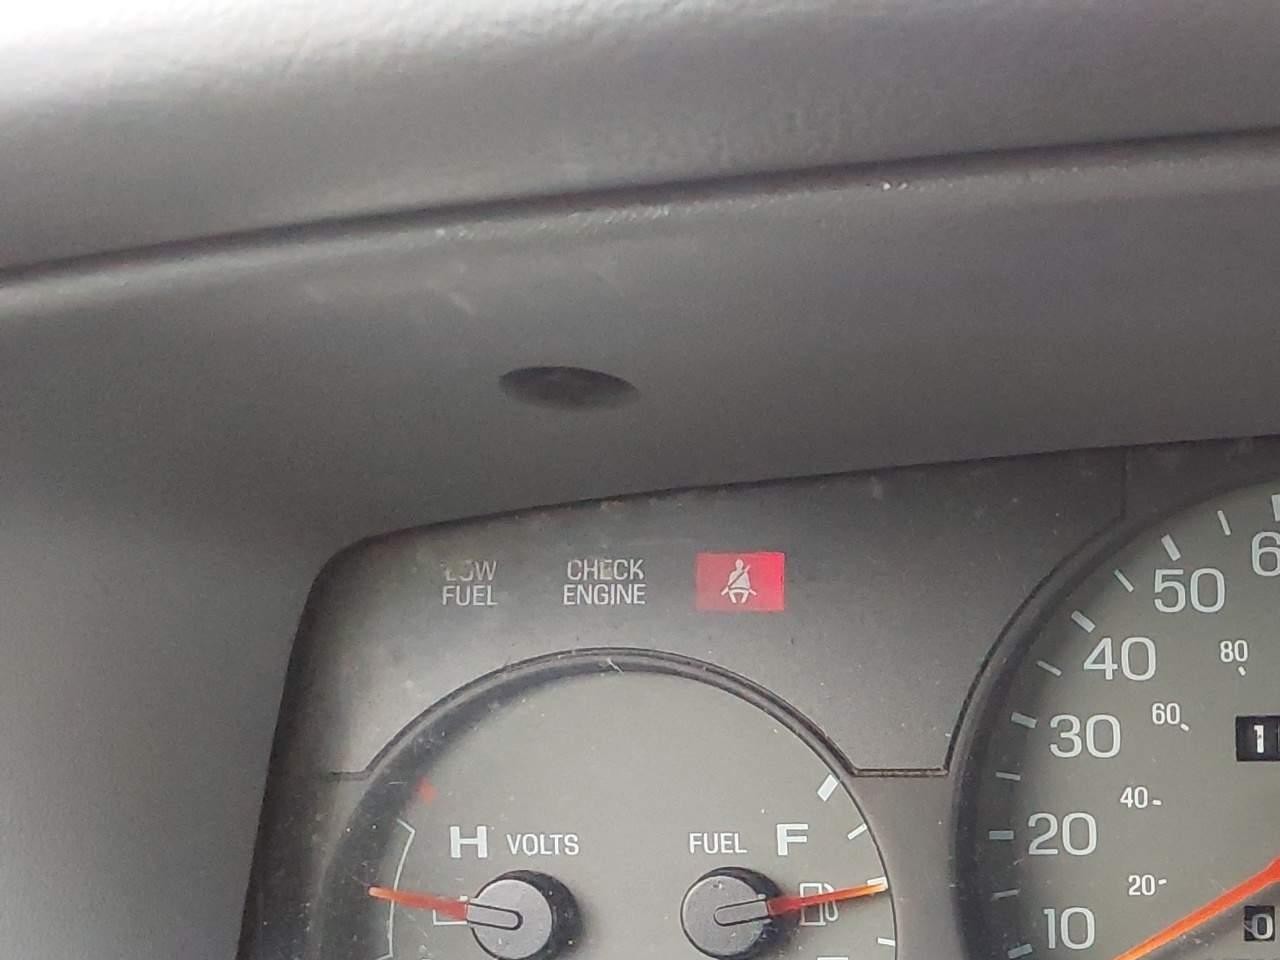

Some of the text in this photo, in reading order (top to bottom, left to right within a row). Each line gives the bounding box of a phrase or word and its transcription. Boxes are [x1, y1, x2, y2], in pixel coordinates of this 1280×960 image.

[565, 559, 645, 581] CHECK
[441, 585, 498, 607] FUEL
[562, 583, 647, 607] ENGINE
[1152, 569, 1226, 613] 50
[1083, 638, 1157, 681] 40
[1219, 639, 1249, 664] 80
[1151, 702, 1181, 727] 60
[1048, 714, 1121, 759] 30
[1119, 786, 1150, 809] 40
[449, 826, 489, 858] H
[506, 833, 580, 855] VOLTS
[688, 831, 747, 854] FUEL
[776, 823, 809, 856] F
[1028, 813, 1097, 856] 20
[1128, 874, 1156, 897] 20
[1045, 907, 1095, 950] 10
